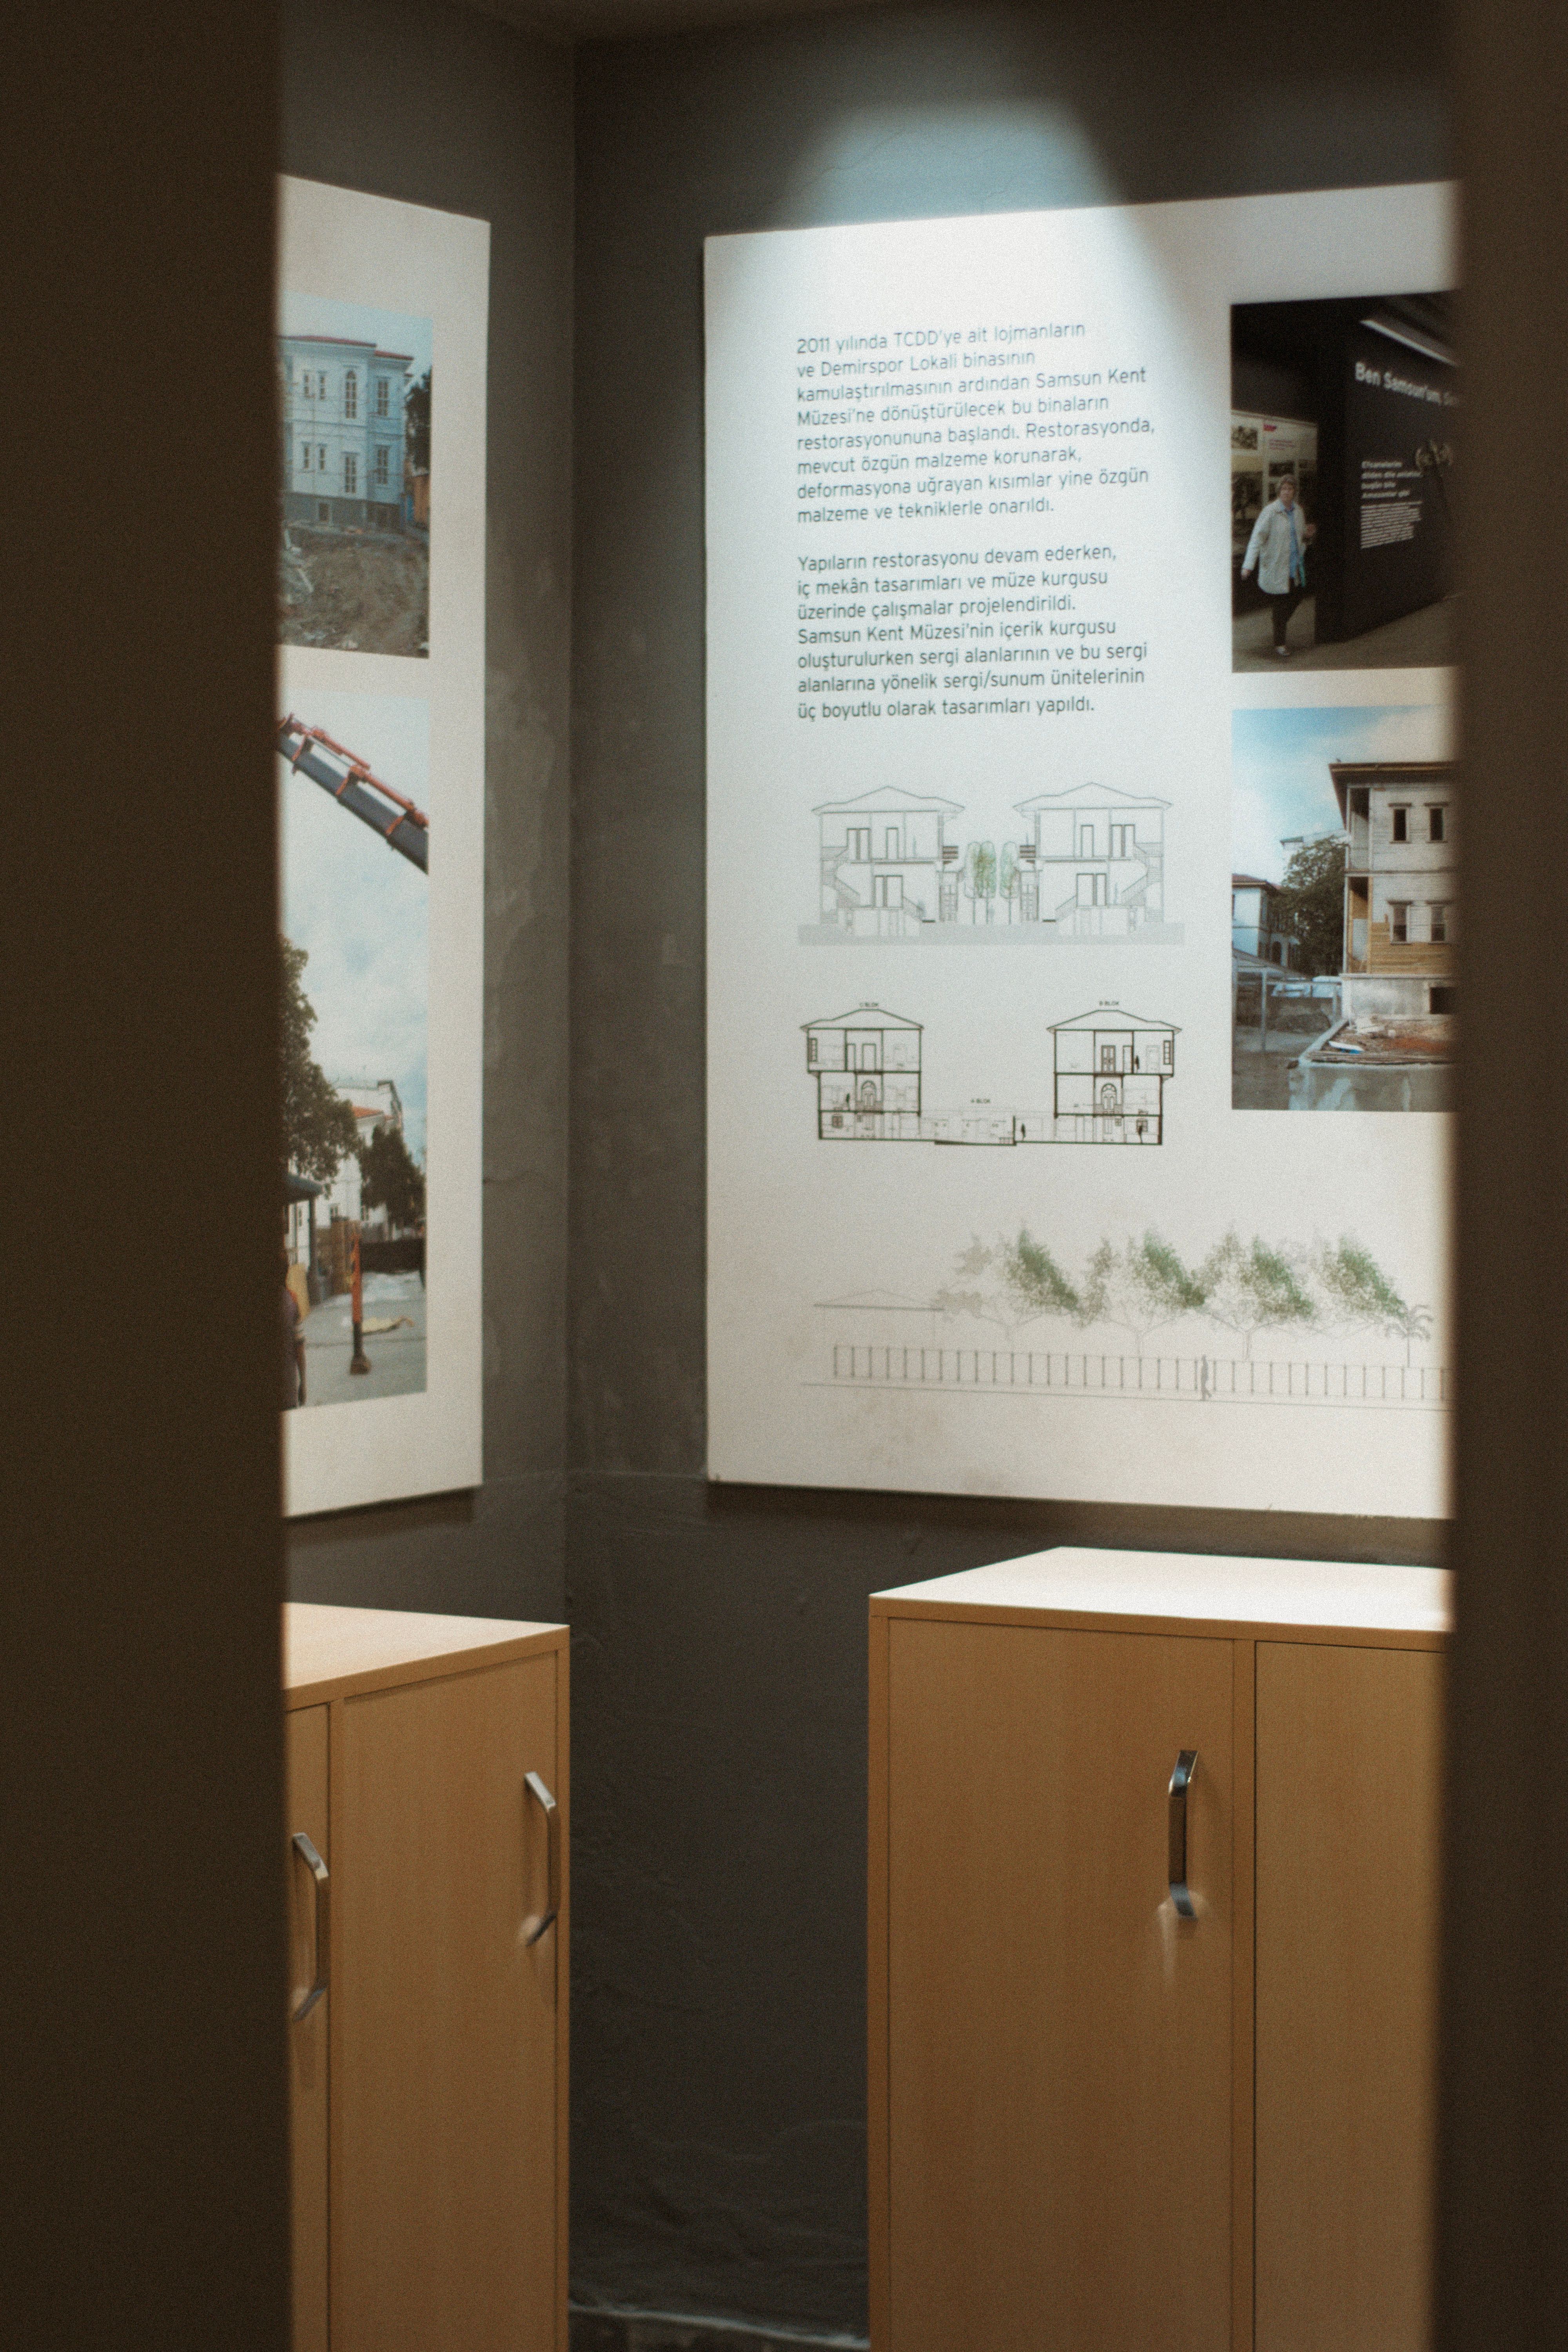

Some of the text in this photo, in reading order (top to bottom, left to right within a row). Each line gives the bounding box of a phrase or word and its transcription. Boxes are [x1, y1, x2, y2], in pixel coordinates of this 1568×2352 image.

[796, 323, 1085, 355] 2011 yılında TCDD'ye ait lojmanların
[796, 351, 1035, 378] ve Demirspor Lokali binasının
[796, 366, 1147, 403] kamulaştırılmasının ardından Samsun Kent
[796, 396, 1109, 426] Müzesi'ne dönüştürülecek bu binaların
[796, 417, 1155, 451] restorasyonununa başlandı. Restorasyonda,
[797, 445, 1082, 475] mevcut özgün malzeme korunarak,
[796, 466, 1149, 500] deformasyona uğrayan kısımlar yine özgün
[797, 496, 1054, 524] malzeme ve tekniklerle onarıldı.
[797, 544, 1117, 574] Yapıların restorasyonu devam ederken,
[797, 570, 1109, 600] iç mekân tasarımları ve müze kurgusu
[797, 594, 1076, 622] üzerinde çalışmalar projelendirildi.
[797, 619, 1117, 645] Samsun Kent Müzesi'nin içerik kurgusu
[797, 641, 1148, 672] oluşturulurken sergi alanlarının ve bu sergi
[797, 666, 1145, 695] alanlarına yönelik sergi/sunum ünitelerinin
[797, 695, 1095, 723] üç boyutlu olarak tasarımları yapıldı.
